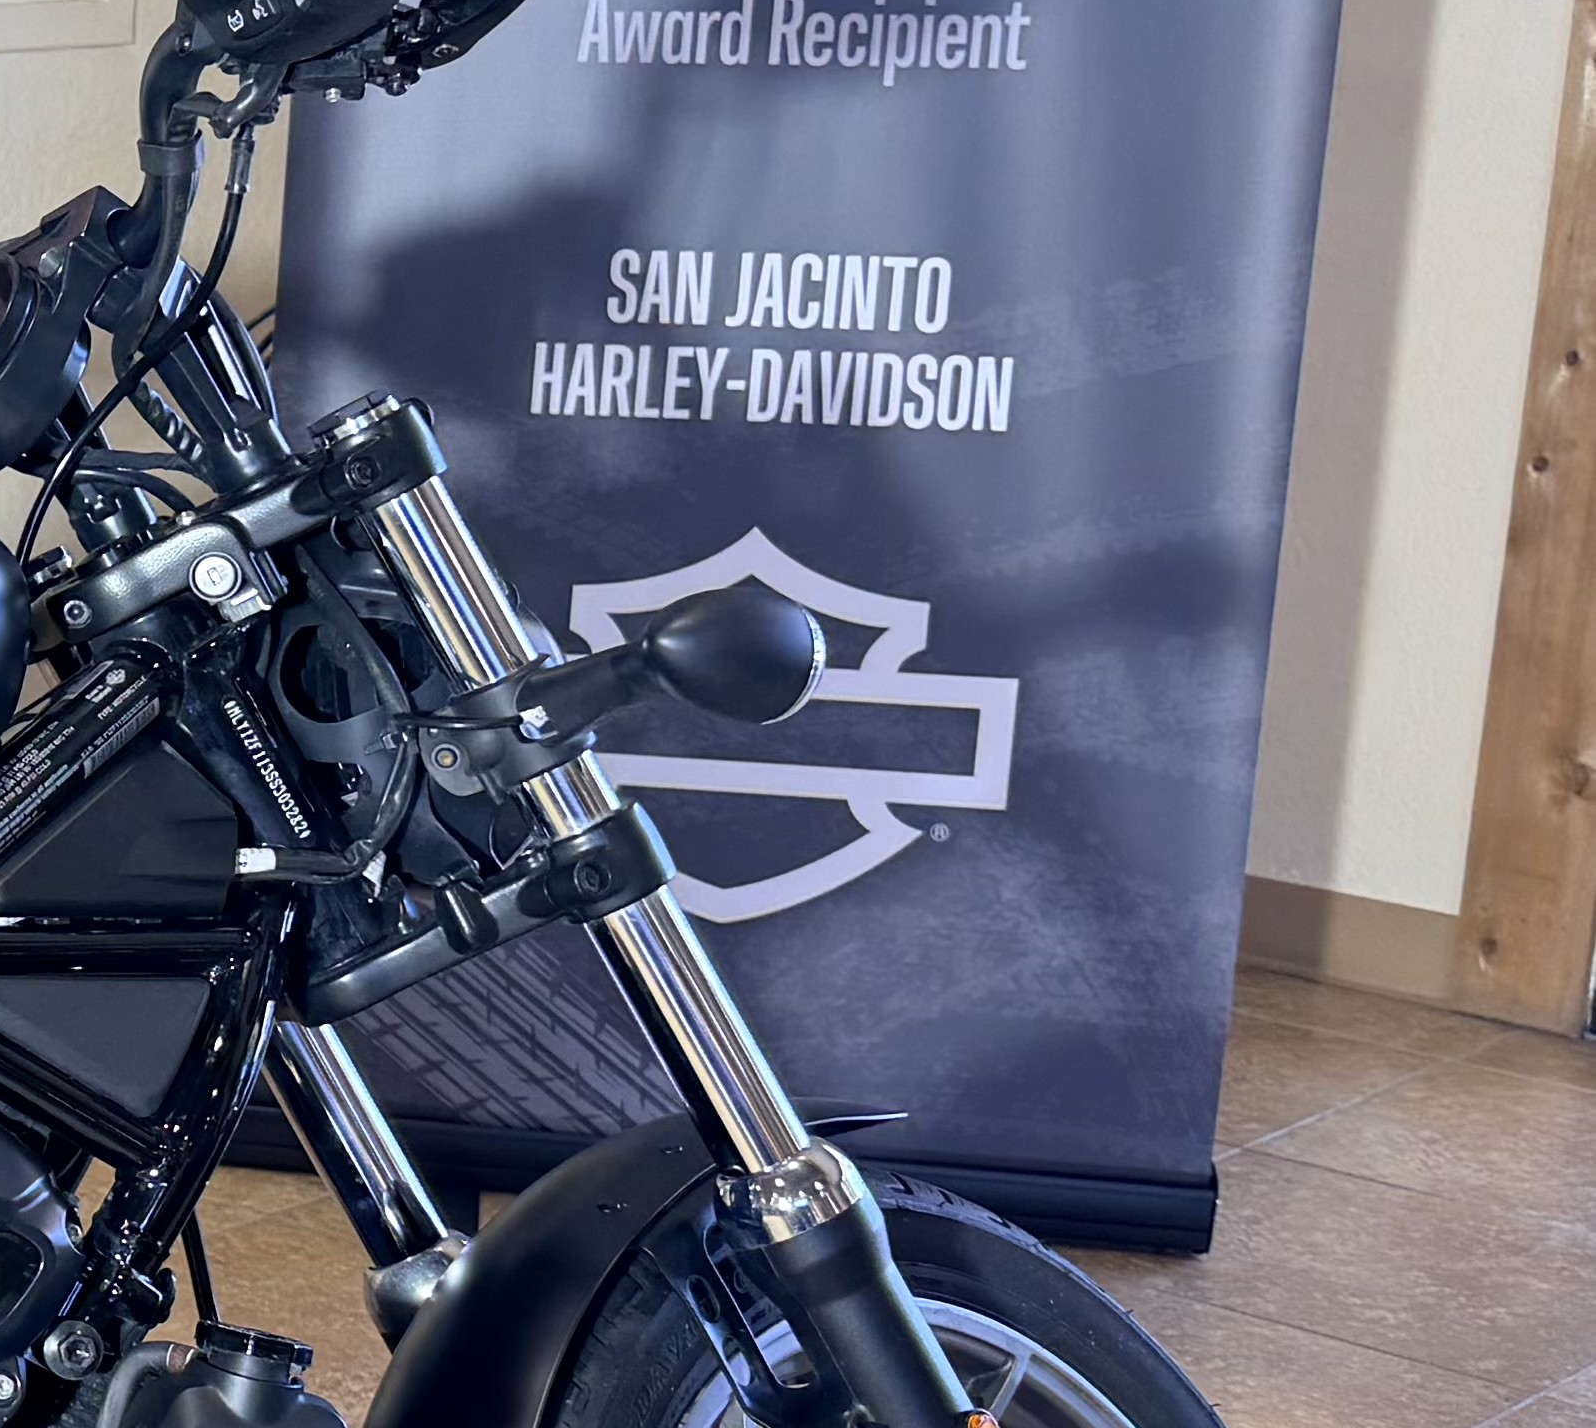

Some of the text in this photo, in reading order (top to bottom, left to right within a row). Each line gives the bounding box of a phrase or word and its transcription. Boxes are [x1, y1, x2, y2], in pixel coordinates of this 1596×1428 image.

[606, 249, 953, 334] SAN JACINTO
[529, 341, 1014, 432] HARLEY-DAVIDSON
